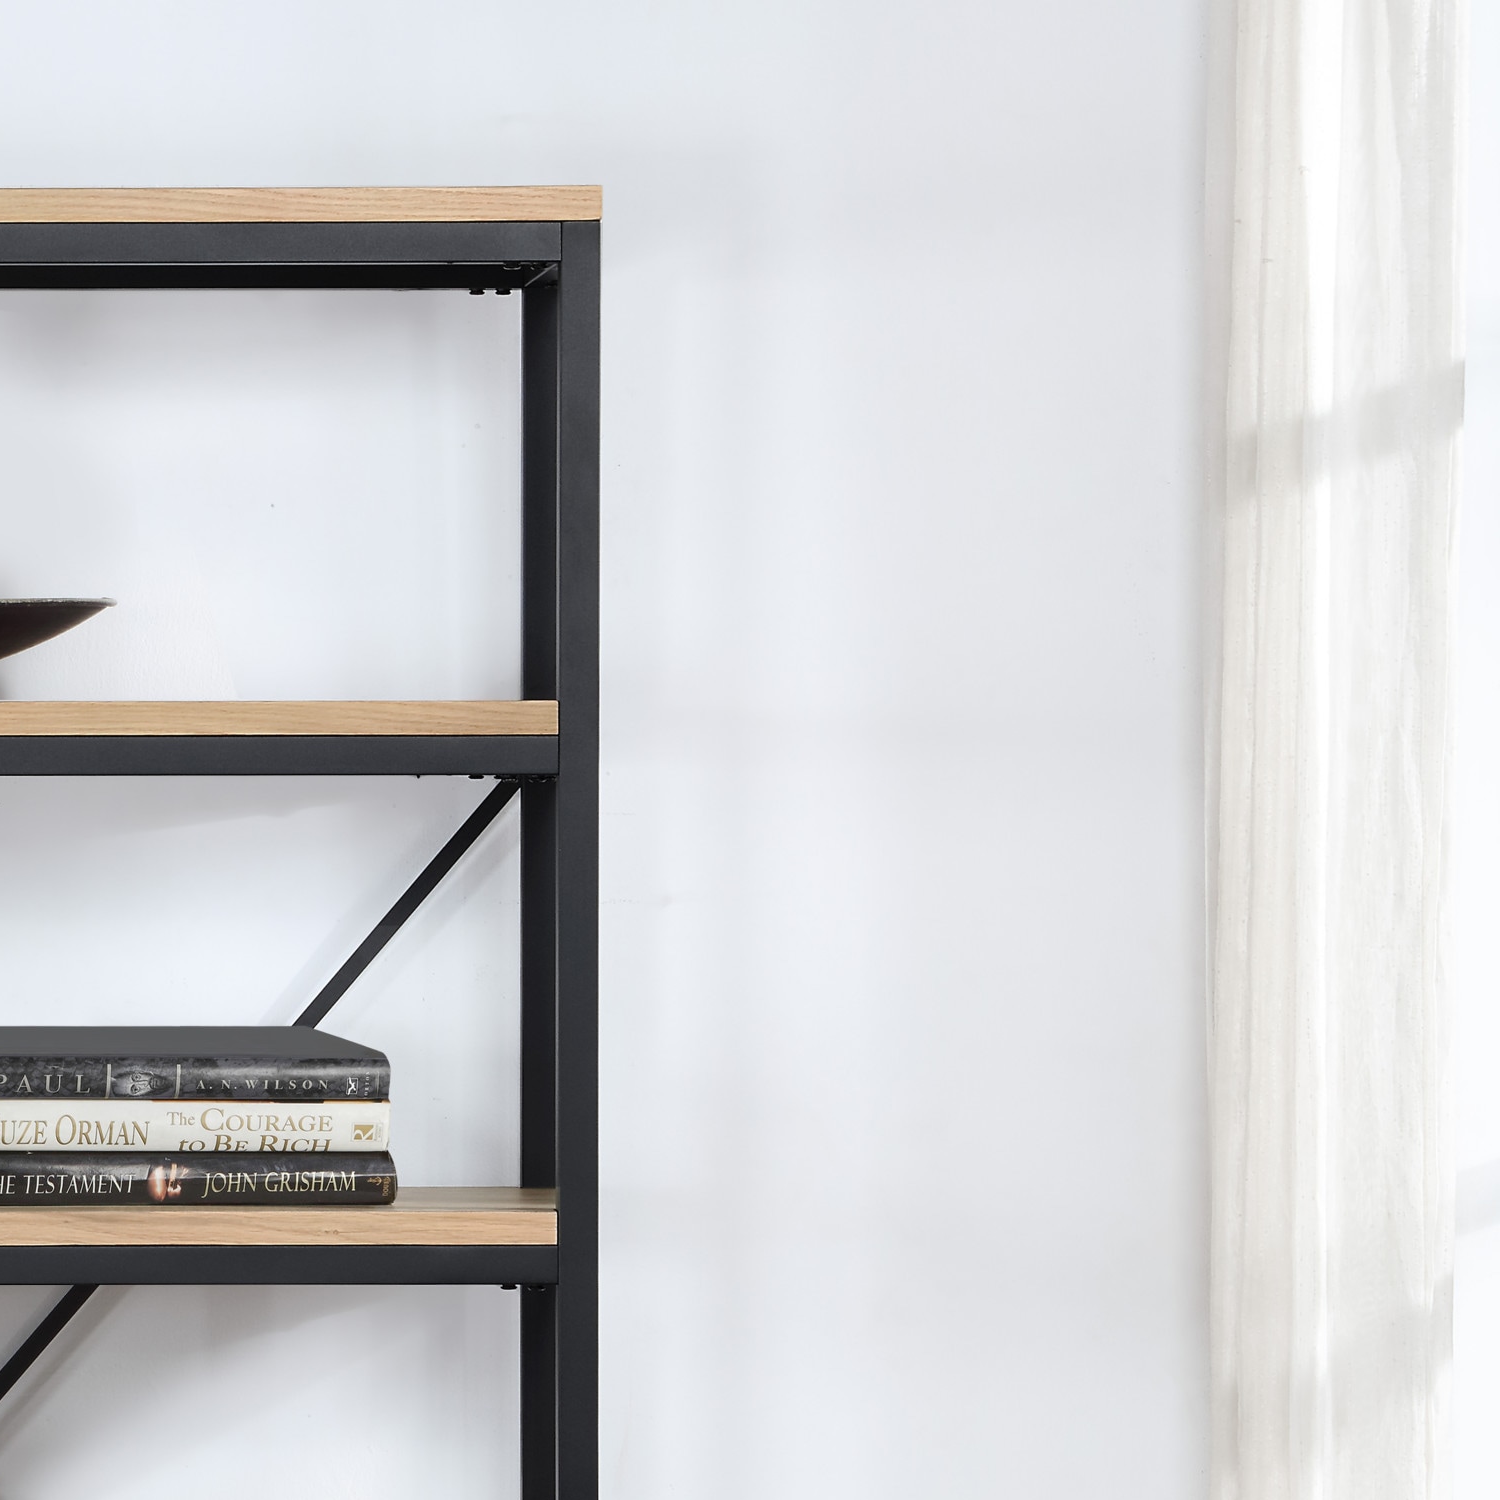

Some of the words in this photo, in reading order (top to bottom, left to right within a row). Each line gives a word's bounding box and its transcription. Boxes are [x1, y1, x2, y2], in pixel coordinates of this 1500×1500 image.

[196, 1079, 213, 1090] A.
[221, 1079, 237, 1090] N.
[246, 1079, 329, 1090] WILSON
[55, 1114, 150, 1146] ORMAN
[166, 1111, 195, 1126] The
[200, 1107, 333, 1133] COURAGE
[179, 1138, 205, 1152] to
[213, 1134, 249, 1152] BE
[259, 1134, 331, 1152] RICH
[23, 1174, 137, 1195] TESTAMENT
[201, 1172, 257, 1198] JOHN
[264, 1171, 357, 1192] GRISHAM
